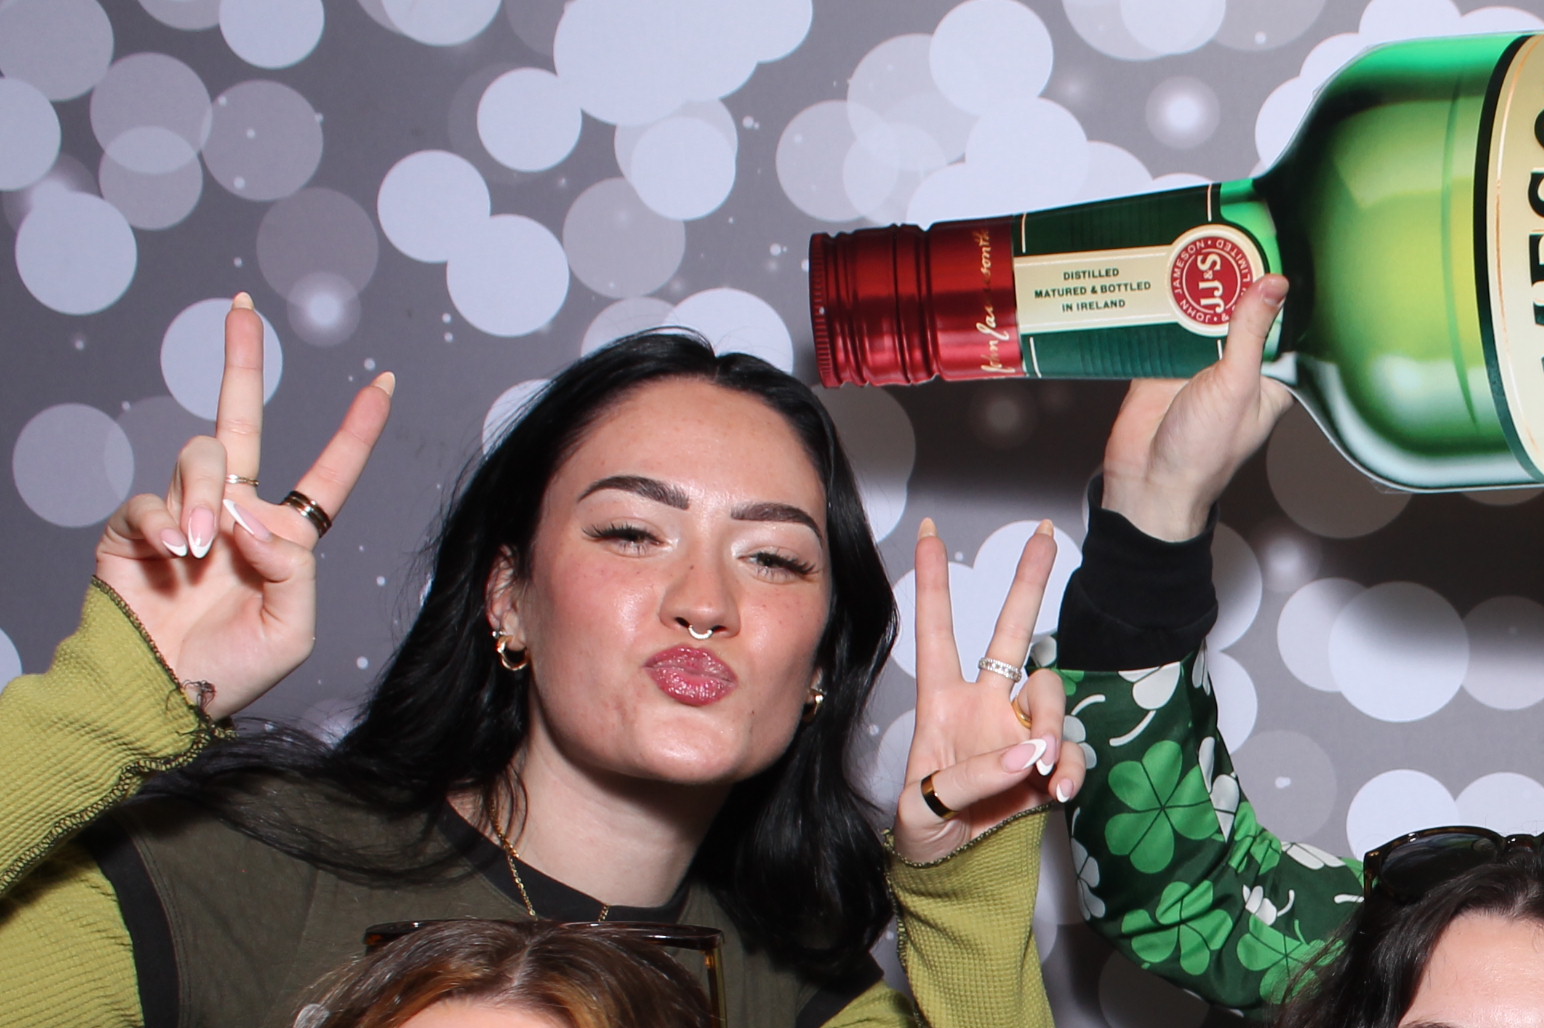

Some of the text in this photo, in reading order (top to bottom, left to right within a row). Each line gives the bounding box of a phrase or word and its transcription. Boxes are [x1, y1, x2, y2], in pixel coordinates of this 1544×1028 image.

[1063, 267, 1120, 281] DISTILLED
[1216, 239, 1251, 283] LIMITED
[1034, 281, 1151, 299] MATURED & BOTTLED
[1173, 240, 1211, 323] JOHN JAMESON
[1196, 253, 1225, 314] JJ&S
[1061, 299, 1126, 313] IN IRELAND
